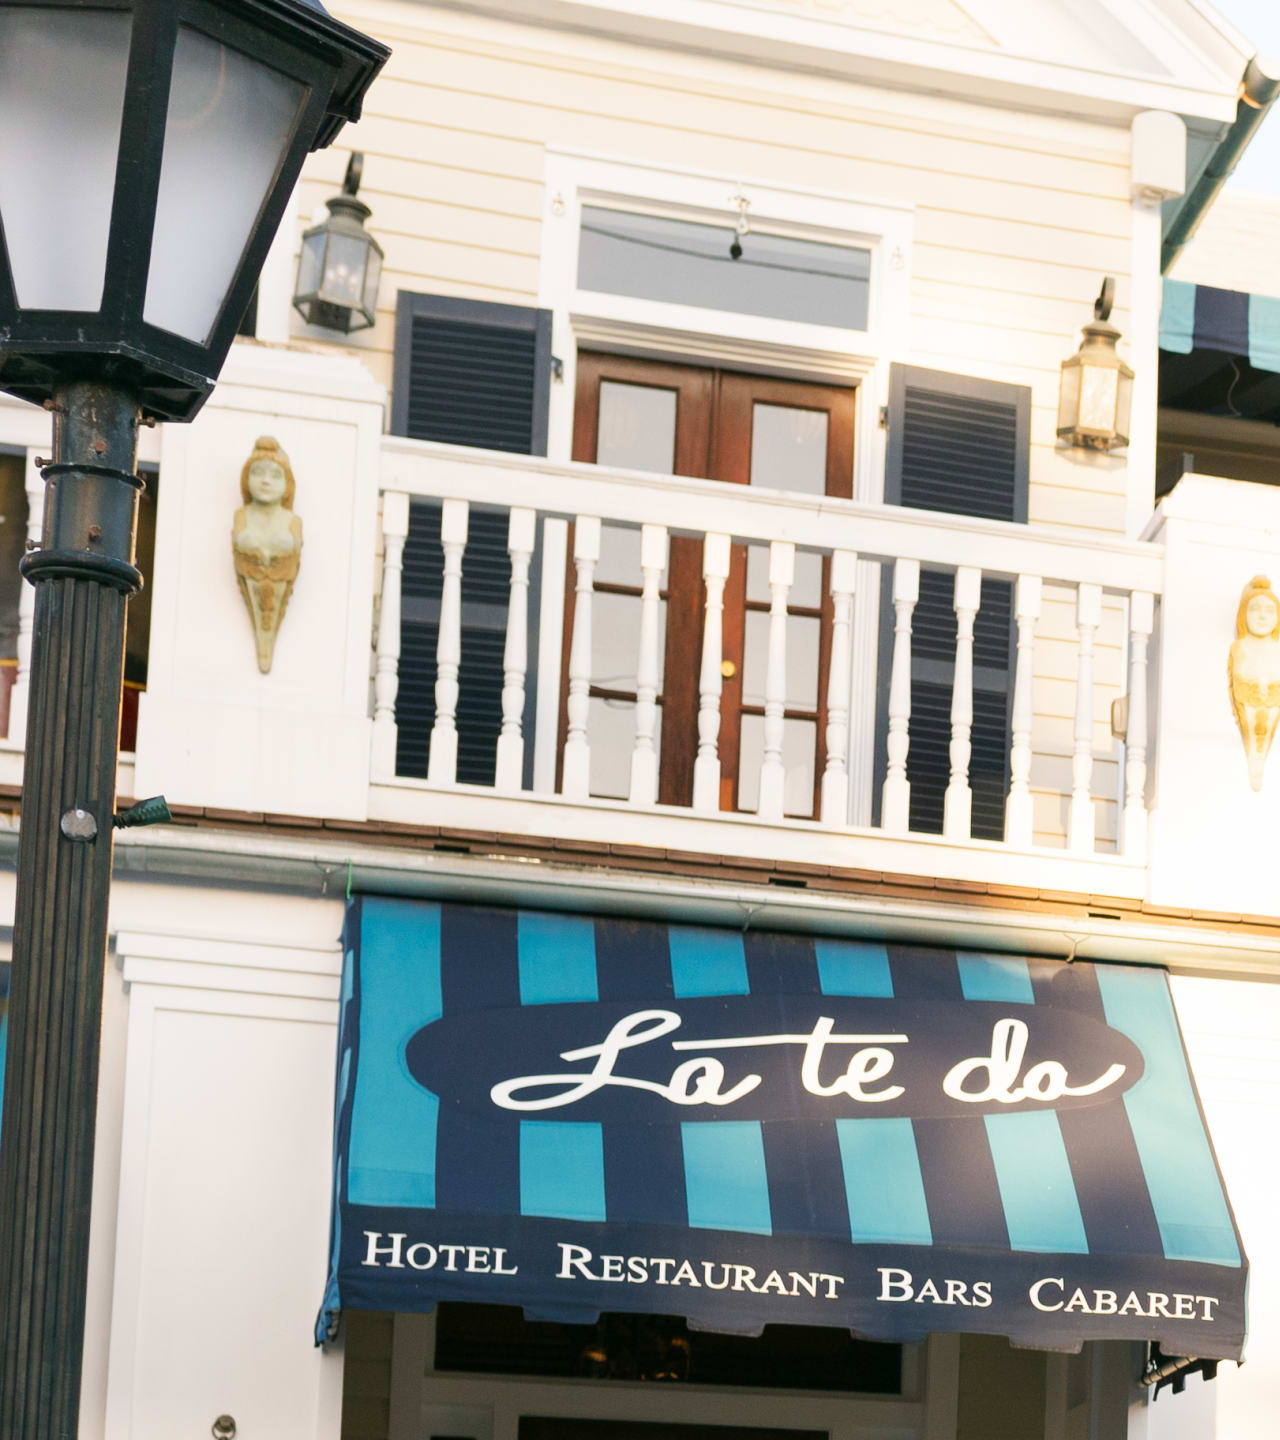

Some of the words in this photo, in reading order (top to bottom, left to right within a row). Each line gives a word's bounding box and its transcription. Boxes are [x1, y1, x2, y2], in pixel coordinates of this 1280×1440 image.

[490, 1009, 762, 1111] La
[671, 1016, 908, 1102] te
[943, 1018, 1126, 1103] da
